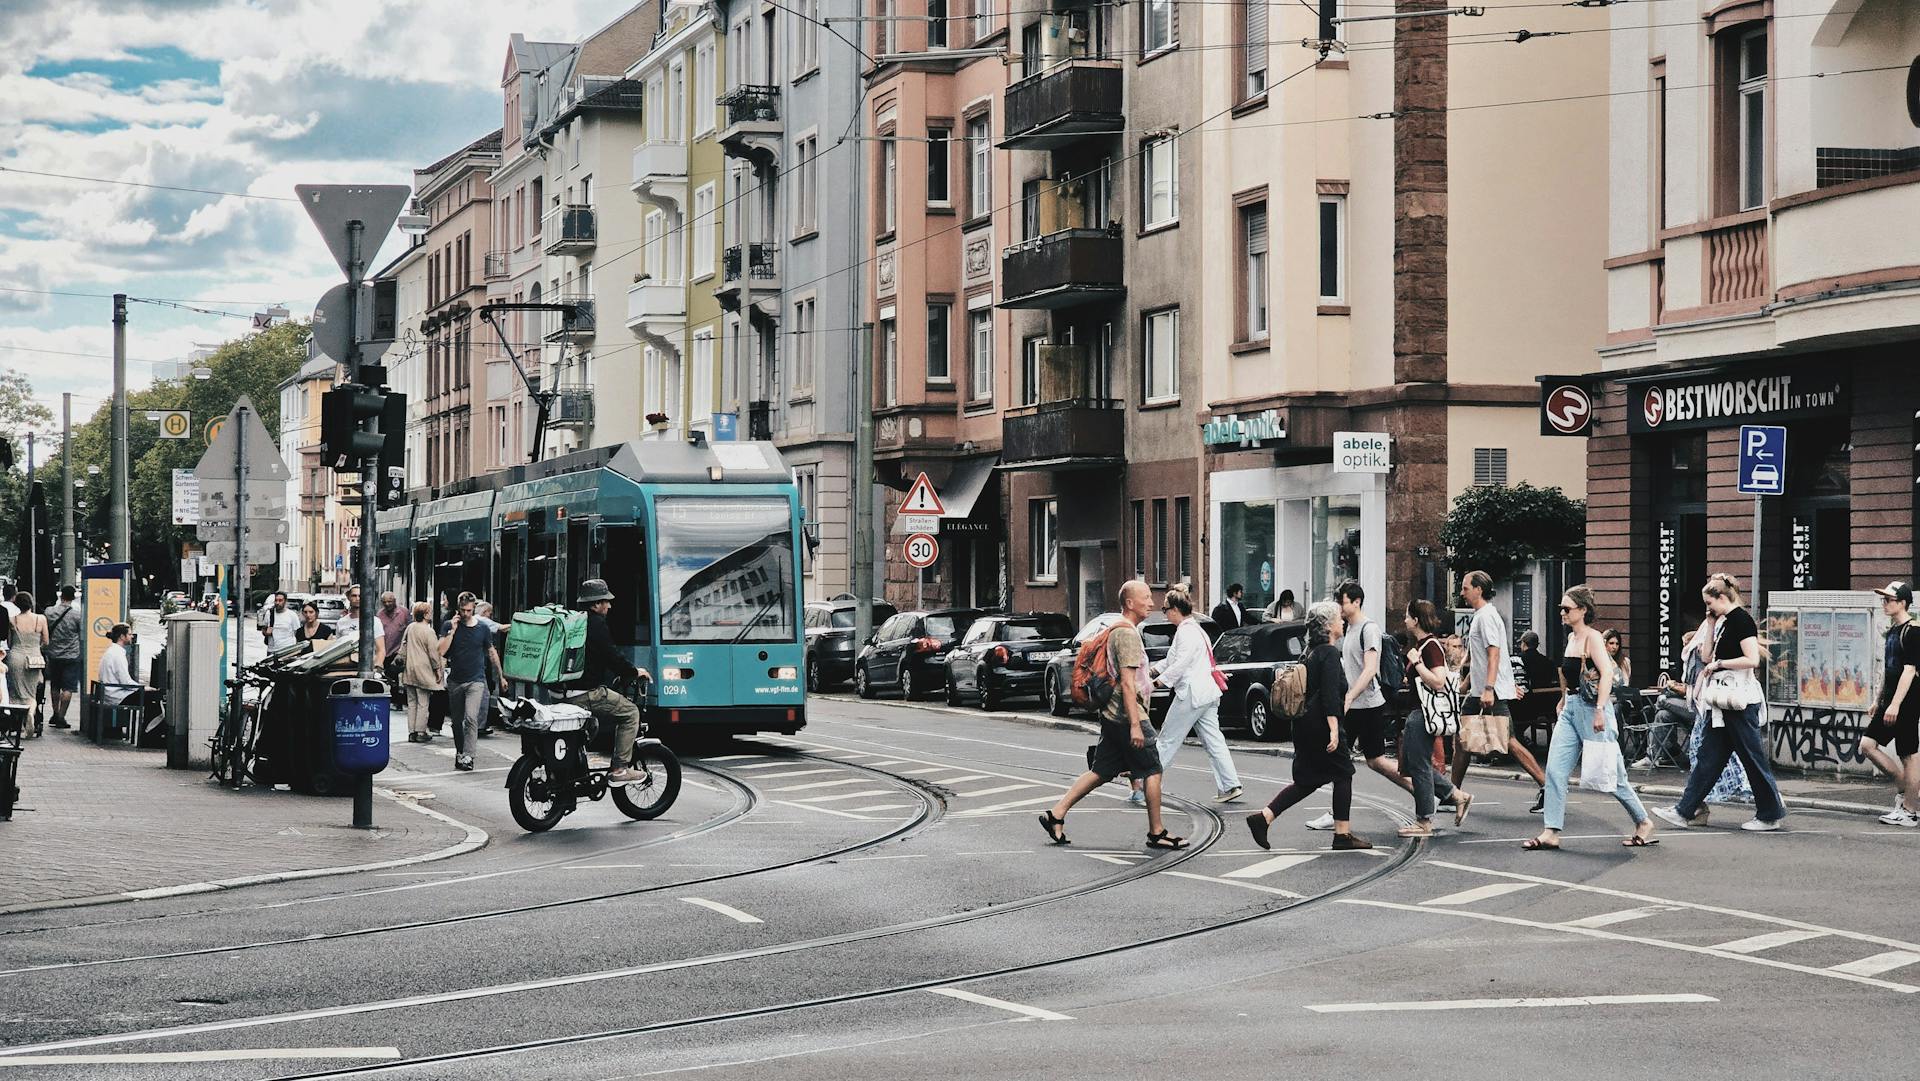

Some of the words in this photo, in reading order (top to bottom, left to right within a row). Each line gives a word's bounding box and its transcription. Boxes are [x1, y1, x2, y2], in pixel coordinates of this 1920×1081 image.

[1666, 376, 1791, 422] BESTWORSCHT
[1790, 395, 1801, 409] IN
[1806, 391, 1834, 408] TOWN
[1343, 437, 1386, 452] abele,
[1747, 431, 1767, 457] P
[1342, 452, 1386, 470] optik.
[911, 542, 931, 558] 30
[1659, 527, 1670, 670] BESTWORSCHT
[663, 685, 679, 695] 029
[681, 685, 687, 694] A
